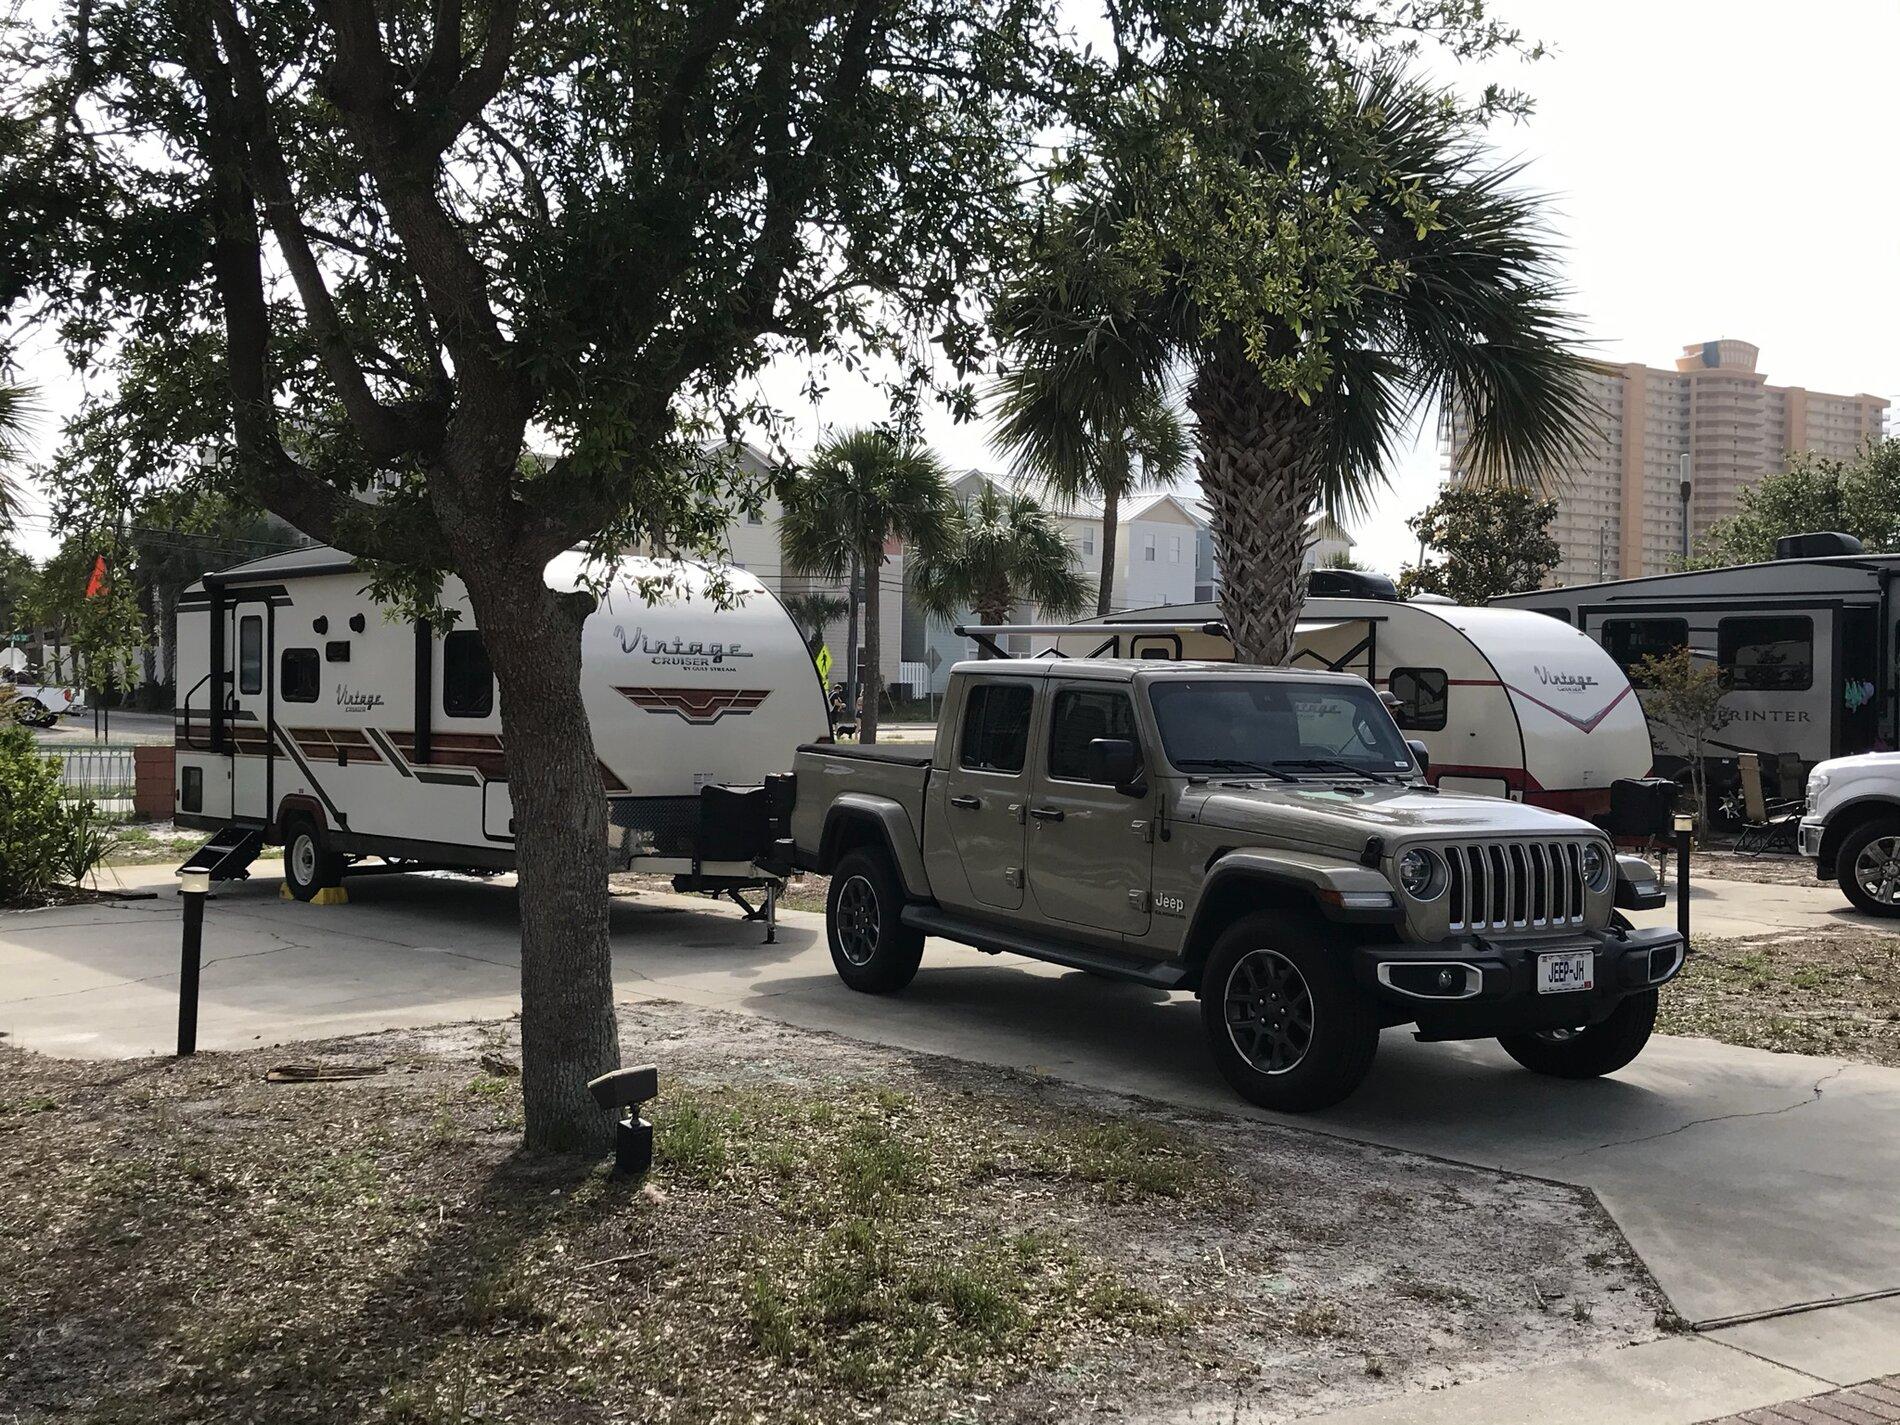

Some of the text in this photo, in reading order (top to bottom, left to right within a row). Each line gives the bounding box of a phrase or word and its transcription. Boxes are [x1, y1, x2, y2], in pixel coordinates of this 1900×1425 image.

[613, 624, 754, 664] Vintage
[651, 656, 710, 666] CRUISER
[1533, 665, 1599, 690] Vintage
[336, 683, 385, 711] Vintage
[1155, 892, 1184, 913] Jeep
[1548, 960, 1584, 983] JEEP-JH
